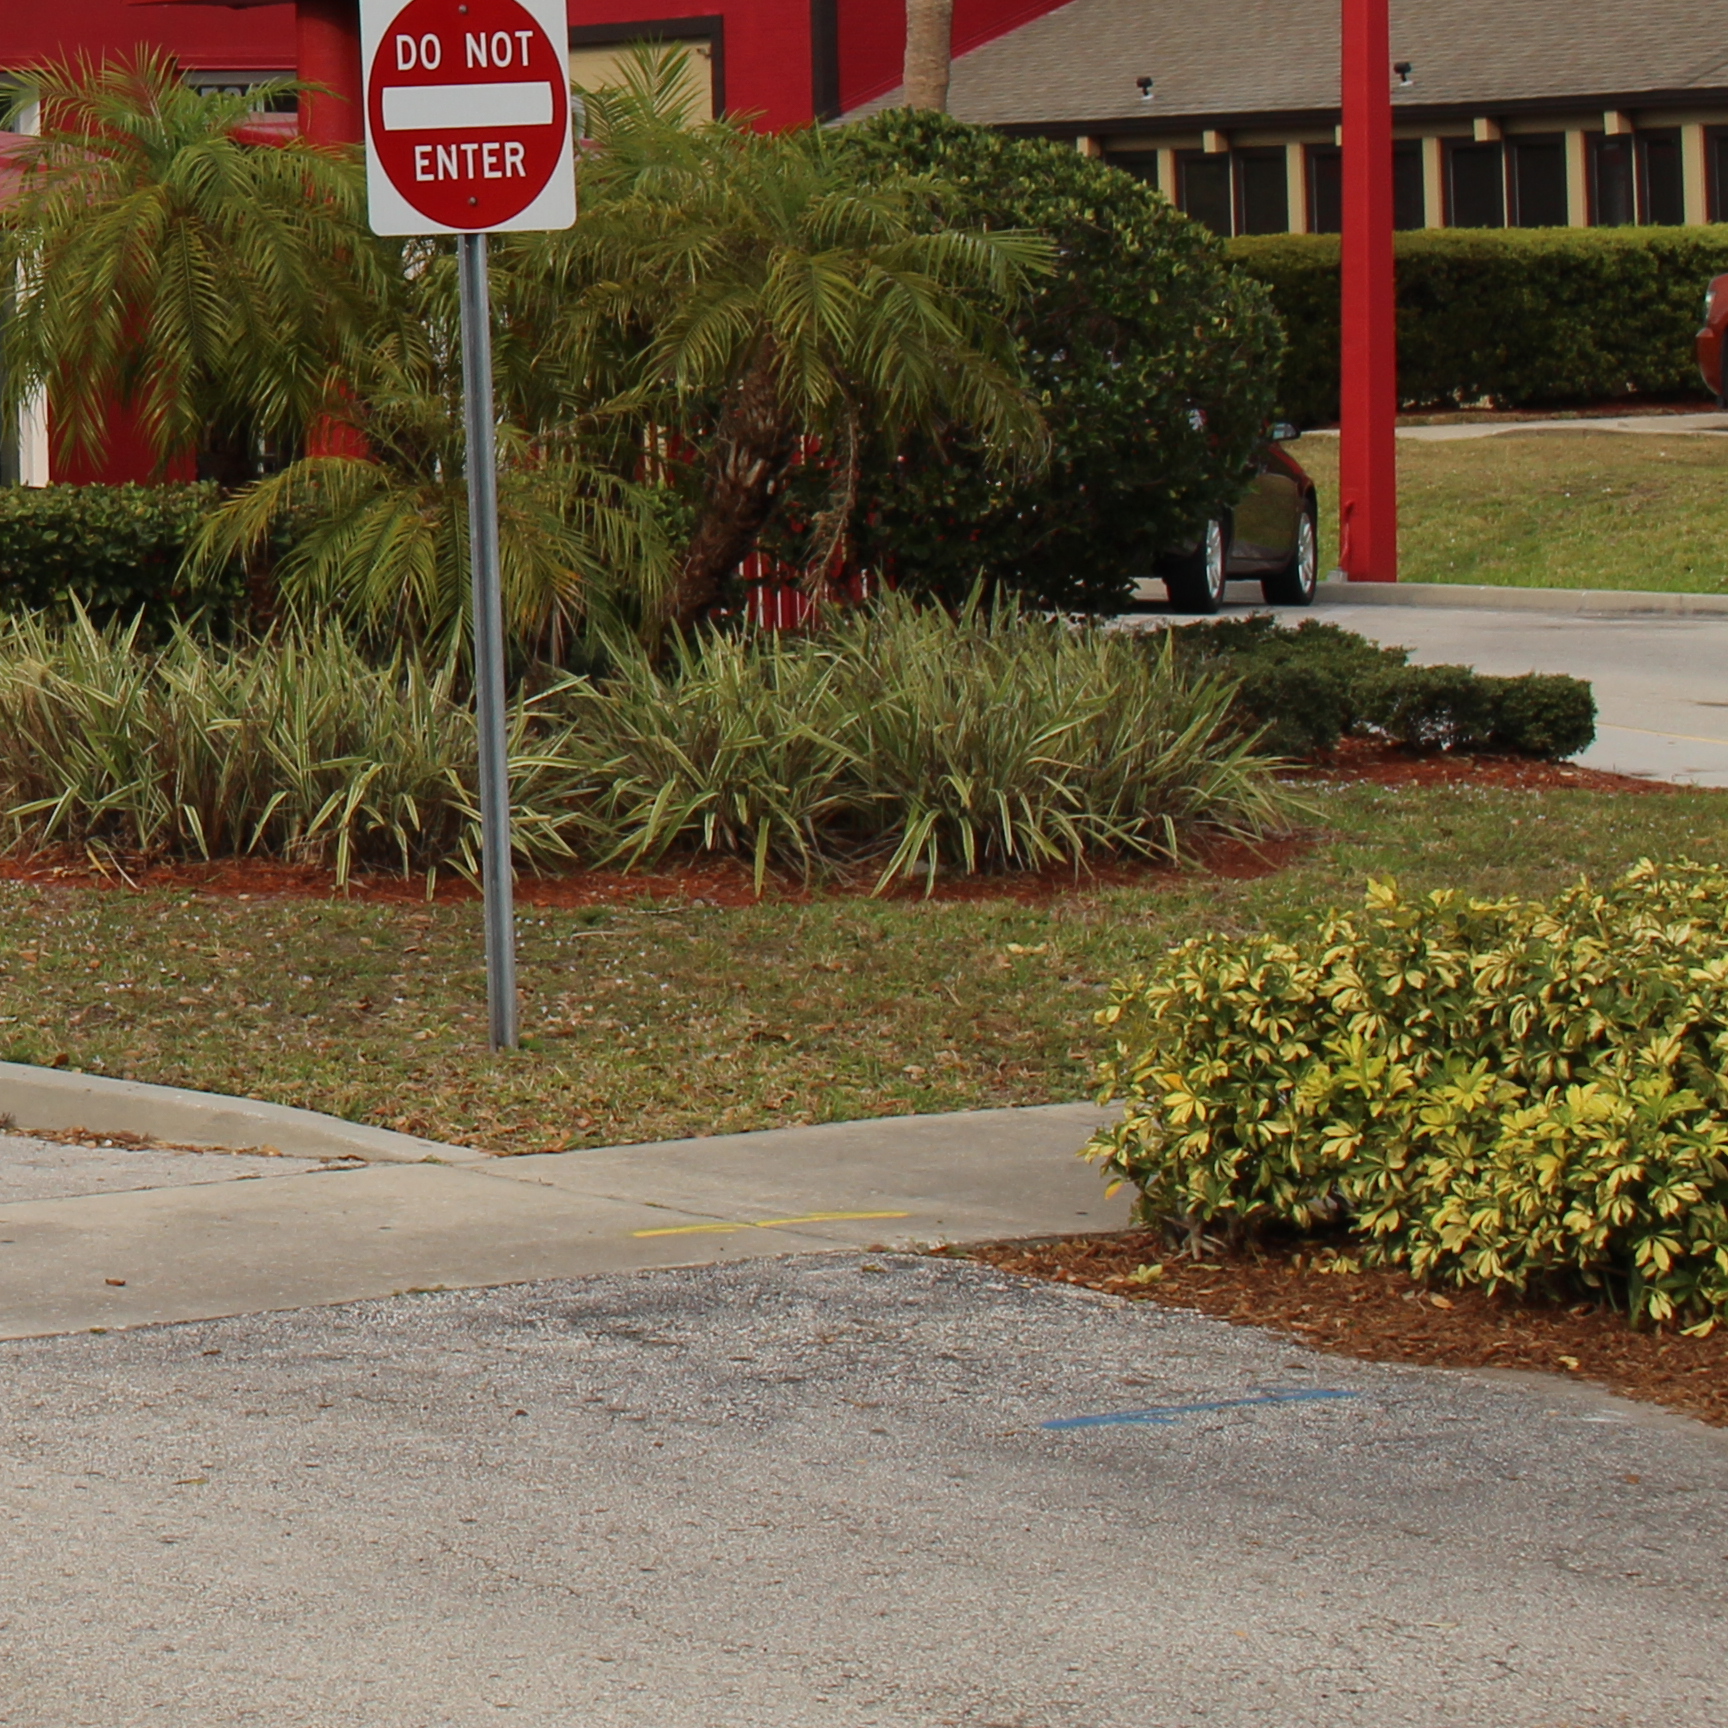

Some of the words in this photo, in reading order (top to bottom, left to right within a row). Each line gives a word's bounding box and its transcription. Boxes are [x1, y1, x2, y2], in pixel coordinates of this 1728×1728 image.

[395, 32, 441, 72] DO
[465, 29, 533, 69] NOT
[413, 141, 526, 182] ENTER
